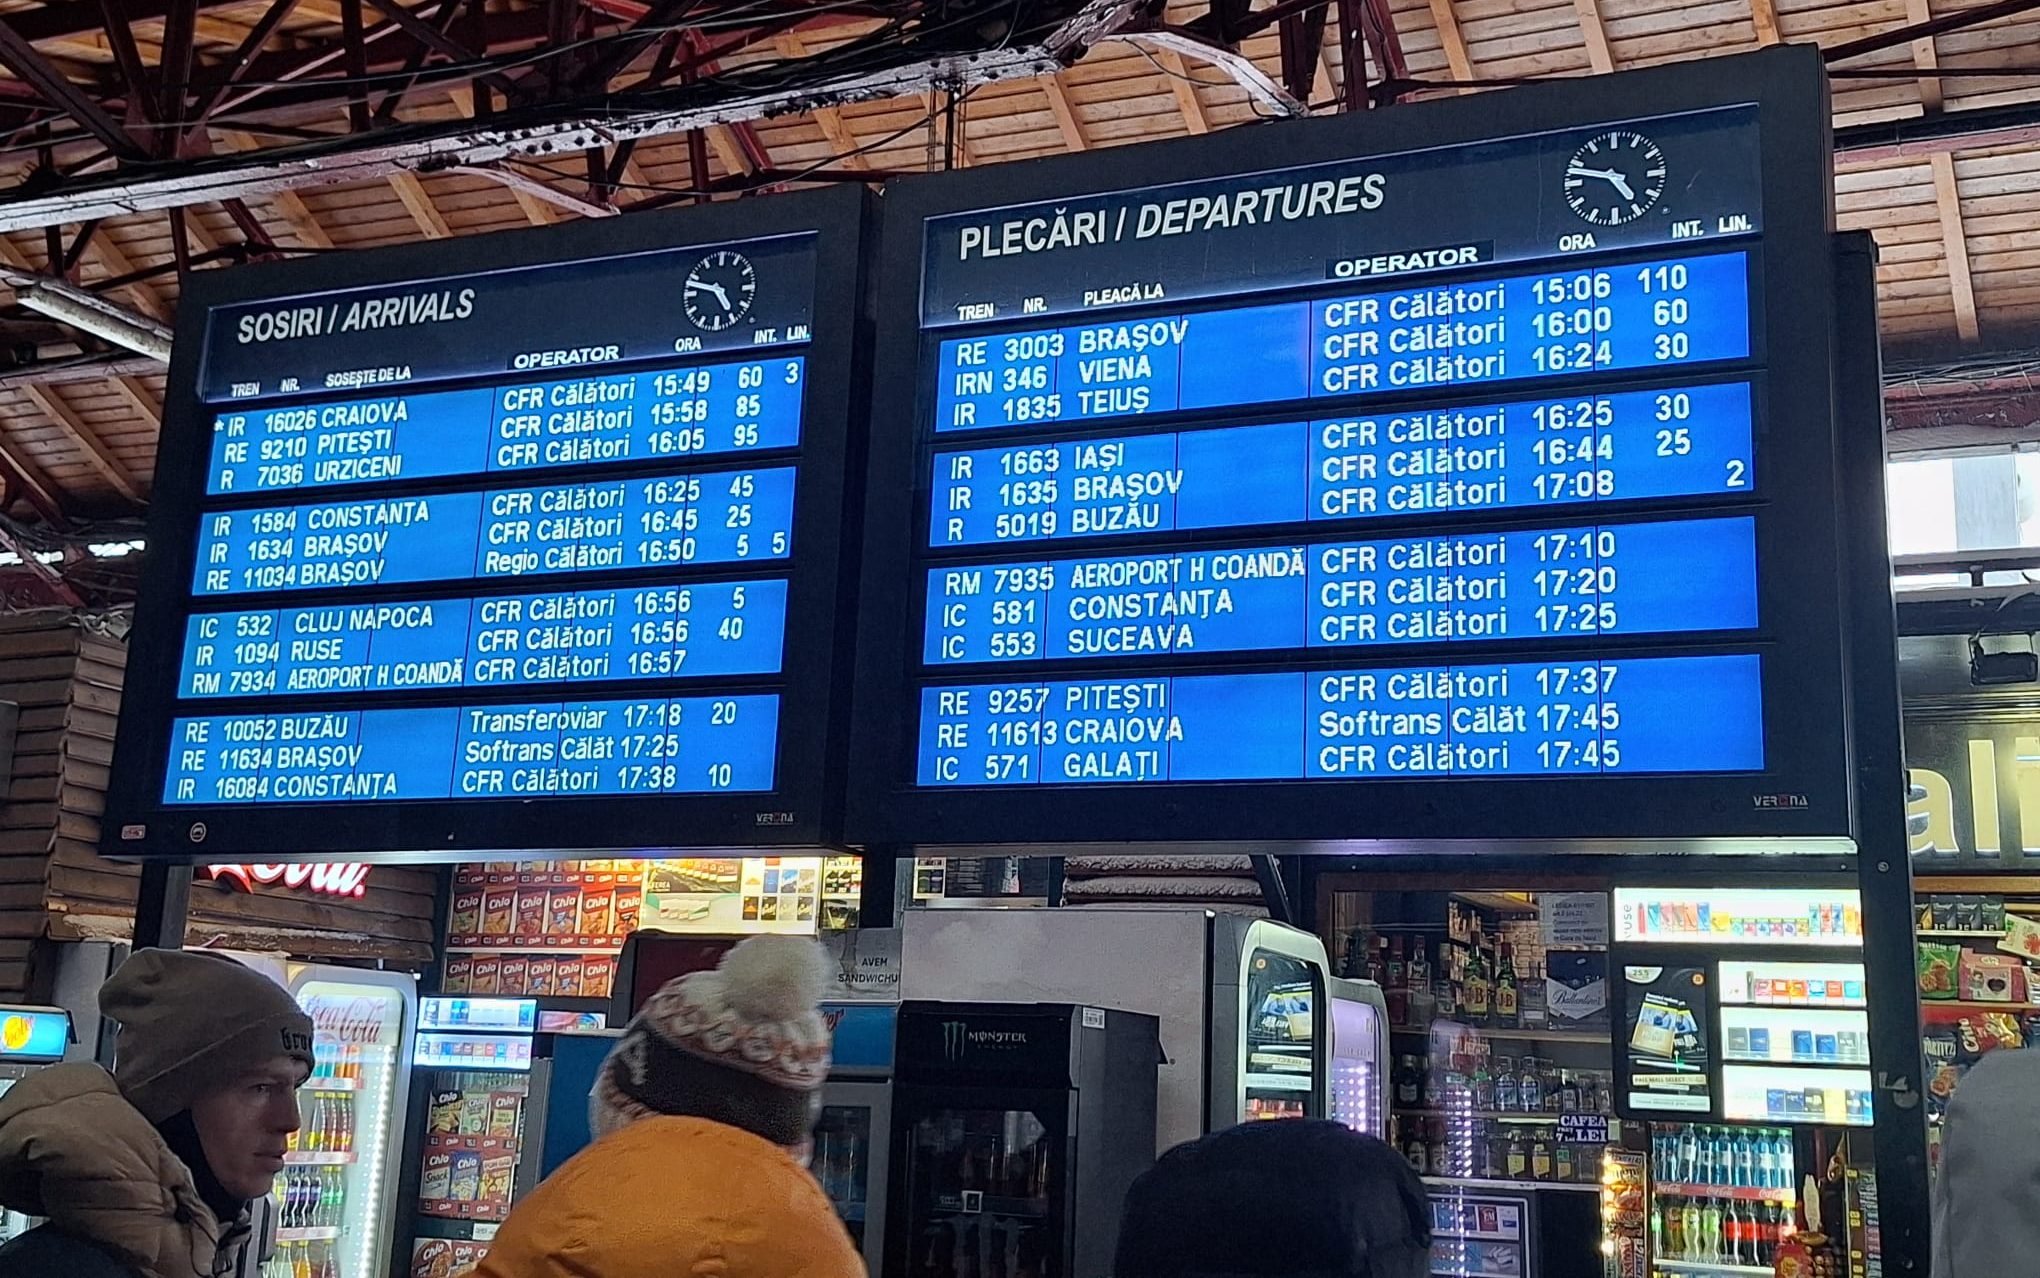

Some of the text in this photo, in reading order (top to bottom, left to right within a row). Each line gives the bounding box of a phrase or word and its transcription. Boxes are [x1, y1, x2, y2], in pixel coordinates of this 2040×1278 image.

[959, 173, 1386, 260] PLECĂRI / DEPARTURES
[957, 214, 1752, 321] TREN NR. PLEACĂ LA OPERATOR ORA INT. LIN.
[238, 288, 476, 344] SOSIRI / ARRIVALS
[231, 382, 260, 398] TREN
[280, 378, 300, 392] NR.
[378, 367, 395, 382] DE
[395, 365, 412, 380] LA
[514, 345, 619, 369] OPERATOR
[675, 337, 702, 352] ORA
[754, 329, 777, 344] INT.
[786, 325, 811, 341] LIN.
[955, 370, 993, 396] IRN
[1003, 365, 1047, 391] 346
[1079, 350, 1152, 384] VIENA
[1324, 331, 1378, 360] CFR
[1532, 306, 1611, 338] 16:00
[1654, 298, 1687, 326] 60
[228, 416, 246, 437] IR
[265, 409, 317, 433] 16026
[321, 400, 407, 428] CRAIOVA
[503, 387, 544, 411] CFR
[654, 371, 710, 396] 15:49
[738, 366, 763, 389] 60
[785, 362, 798, 384] 3
[221, 469, 234, 489] R
[258, 463, 304, 486] 7036
[314, 454, 402, 482] URZICENI
[497, 442, 539, 467] CFR
[648, 428, 705, 453] 16:05
[734, 424, 758, 446] 95
[951, 456, 972, 480] IR
[1001, 448, 1060, 475] 1663
[1322, 421, 1377, 449] CFR
[1533, 400, 1612, 431] 16:25
[1655, 393, 1689, 421] 30
[948, 518, 963, 541] R
[996, 511, 1057, 538] 5019
[1072, 502, 1159, 533] BUZĂU
[1322, 487, 1376, 515] CFR
[1533, 469, 1614, 500] 17:08
[1726, 459, 1745, 487] 2
[206, 569, 231, 590] RE
[244, 565, 296, 587] 11034
[485, 548, 539, 575] Regio
[638, 537, 696, 563] 16:50
[737, 534, 749, 557] 5
[772, 531, 785, 554] 5
[946, 571, 981, 595] RM
[994, 566, 1054, 593] 7935
[1071, 558, 1183, 589] AEROPORT
[1190, 557, 1204, 582] H
[1212, 547, 1306, 580] COANDĂ
[1322, 546, 1376, 574] CFR
[1534, 531, 1615, 561] 17:10
[200, 618, 218, 638] IC
[237, 615, 272, 636] 532
[295, 610, 343, 633] CLUJ
[349, 606, 433, 630] NAPOCA
[481, 600, 522, 623] CFR
[634, 590, 691, 614] 16:56
[733, 586, 745, 609] 5
[942, 635, 965, 659] IC
[991, 631, 1036, 657] 553
[1068, 624, 1193, 653] SUCEAVA
[1321, 614, 1376, 642] CFR
[1535, 602, 1616, 632] 17:25
[196, 645, 214, 666] IR
[235, 642, 280, 664] 1094
[291, 638, 343, 661] RUSE
[478, 629, 519, 652] CFR
[631, 619, 689, 644] 16:56
[718, 617, 743, 640] 40
[192, 673, 221, 693] RM
[230, 670, 276, 692] 7934
[287, 665, 373, 689] AEROPORT
[377, 665, 389, 686] H
[393, 658, 463, 685] COANDĂ
[474, 658, 516, 682] CFR
[628, 649, 686, 674] 16:57
[186, 701, 736, 743] RE 10052 BUZĂU Transferoviar 17:18 20
[938, 702, 1619, 748] RE 11613 CRAIOVA Softrans Călăt 17:45
[181, 749, 206, 771] RE
[220, 748, 273, 769] 11634
[465, 740, 554, 763] Softrans
[560, 736, 614, 760] Călăt
[621, 734, 679, 758] 17:25
[457, 897, 479, 909] Chio
[489, 897, 511, 910] Chio
[520, 896, 543, 909] Chio
[552, 895, 576, 909] Chio
[585, 896, 609, 909] Chio
[618, 895, 641, 909] Chio
[450, 962, 469, 974] Chio
[476, 962, 497, 975] Chio
[503, 962, 524, 974] Chio
[862, 957, 888, 967] AVEM
[1560, 1115, 1607, 1127] CAFEA
[1575, 1129, 1607, 1142] LEI
